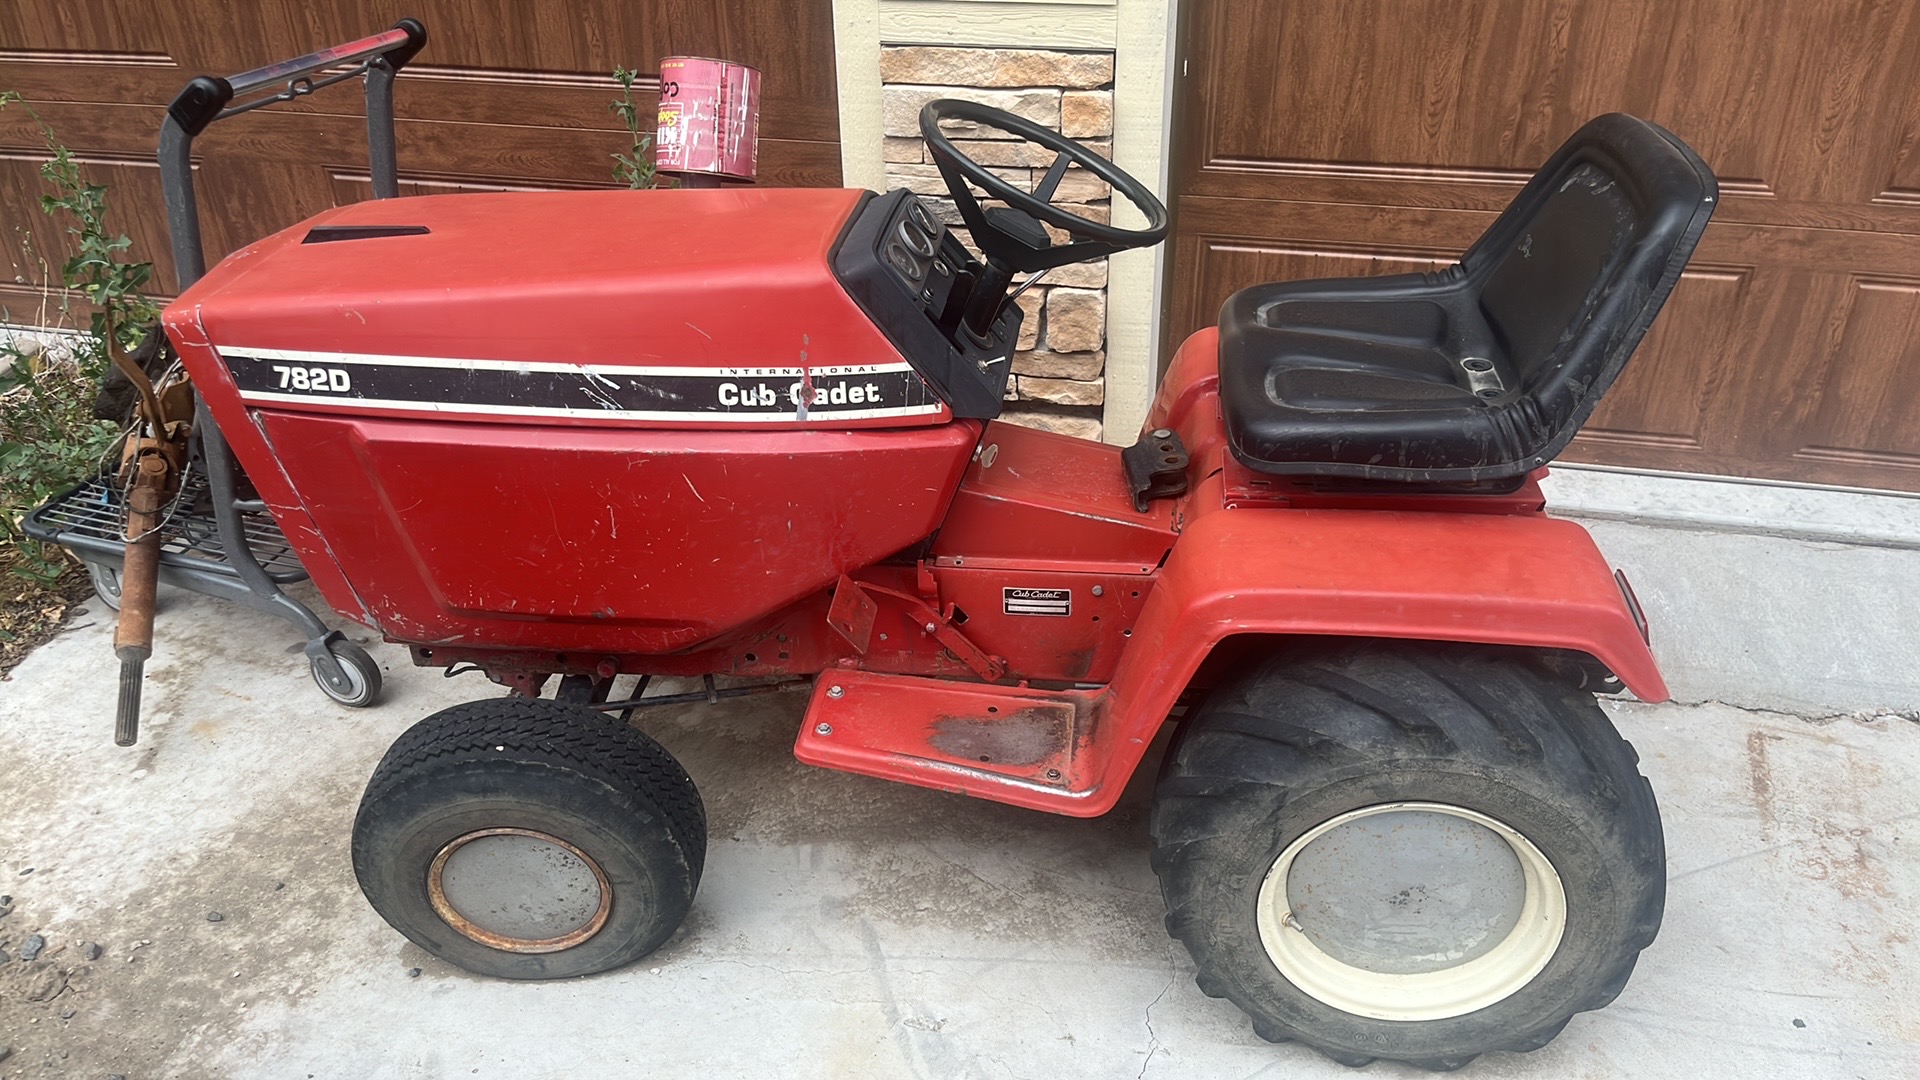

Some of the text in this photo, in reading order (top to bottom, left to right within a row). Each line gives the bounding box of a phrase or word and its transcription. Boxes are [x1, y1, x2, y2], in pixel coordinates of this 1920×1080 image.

[272, 365, 351, 393] 782D
[720, 366, 877, 376] INTERNATIONAL
[718, 383, 777, 407] Cub
[1012, 589, 1062, 598] Cub Cadet
